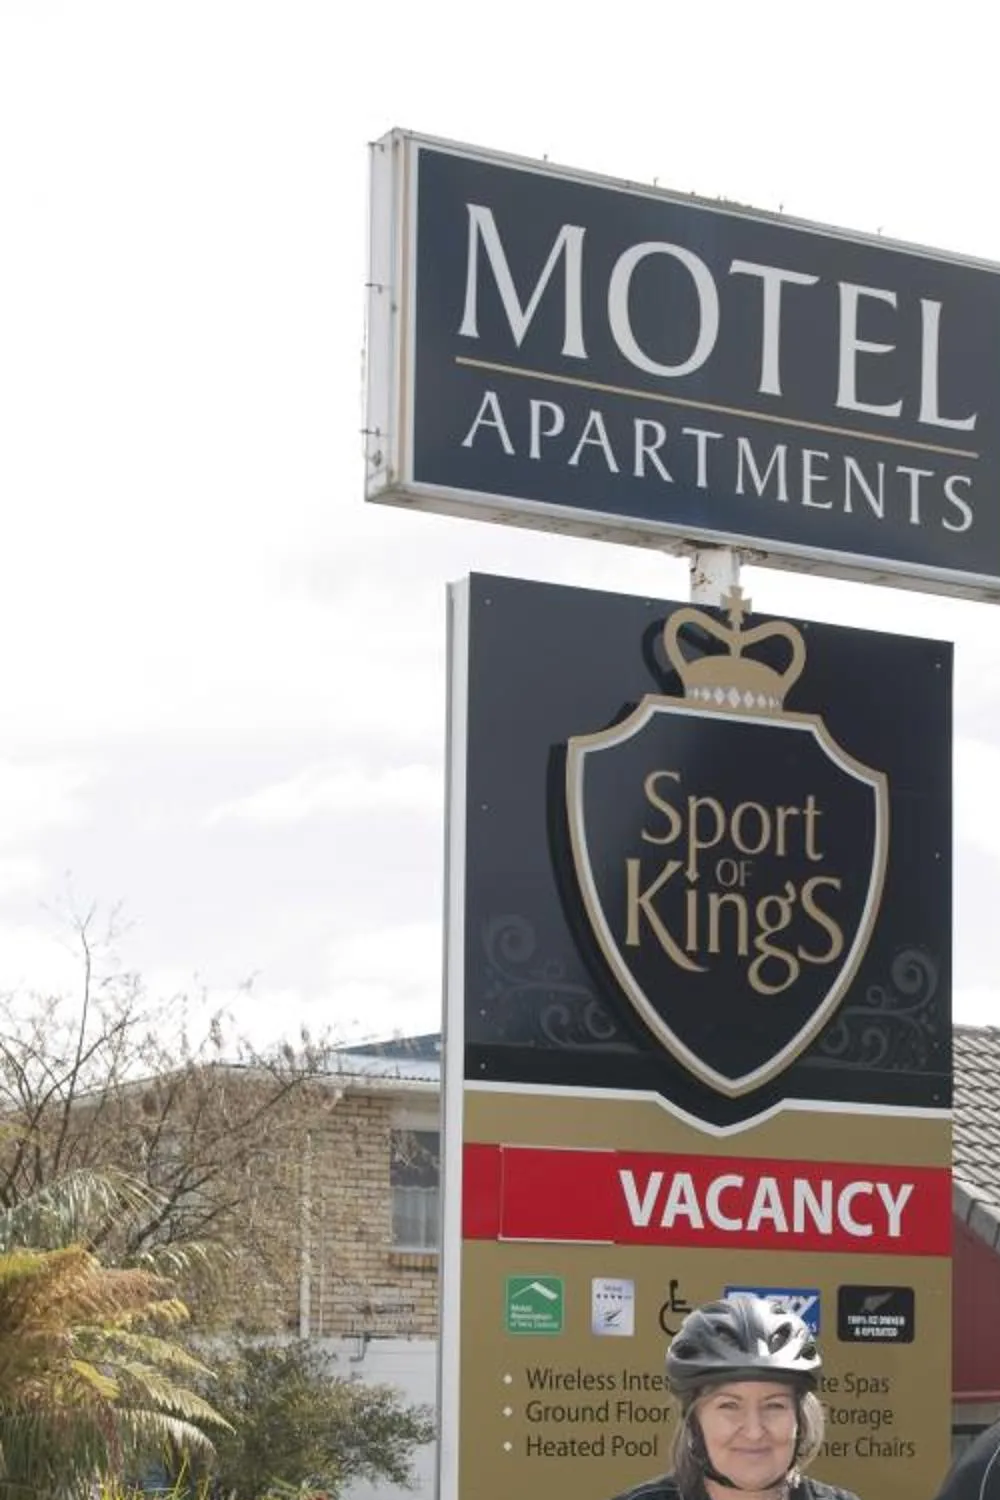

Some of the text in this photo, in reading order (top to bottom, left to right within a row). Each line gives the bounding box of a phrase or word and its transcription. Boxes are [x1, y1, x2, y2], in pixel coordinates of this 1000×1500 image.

[457, 203, 977, 431] MOTEL
[462, 391, 974, 533] APARTMENTS
[641, 771, 824, 884] Sport
[716, 858, 754, 887] OF
[618, 1169, 915, 1238] VACANCY
[526, 1367, 617, 1391] Wireless
[843, 1372, 890, 1398] Spas
[526, 1400, 671, 1423] Ground Floor
[526, 1433, 658, 1457] Heated Pool
[855, 1436, 916, 1458] Chairs
